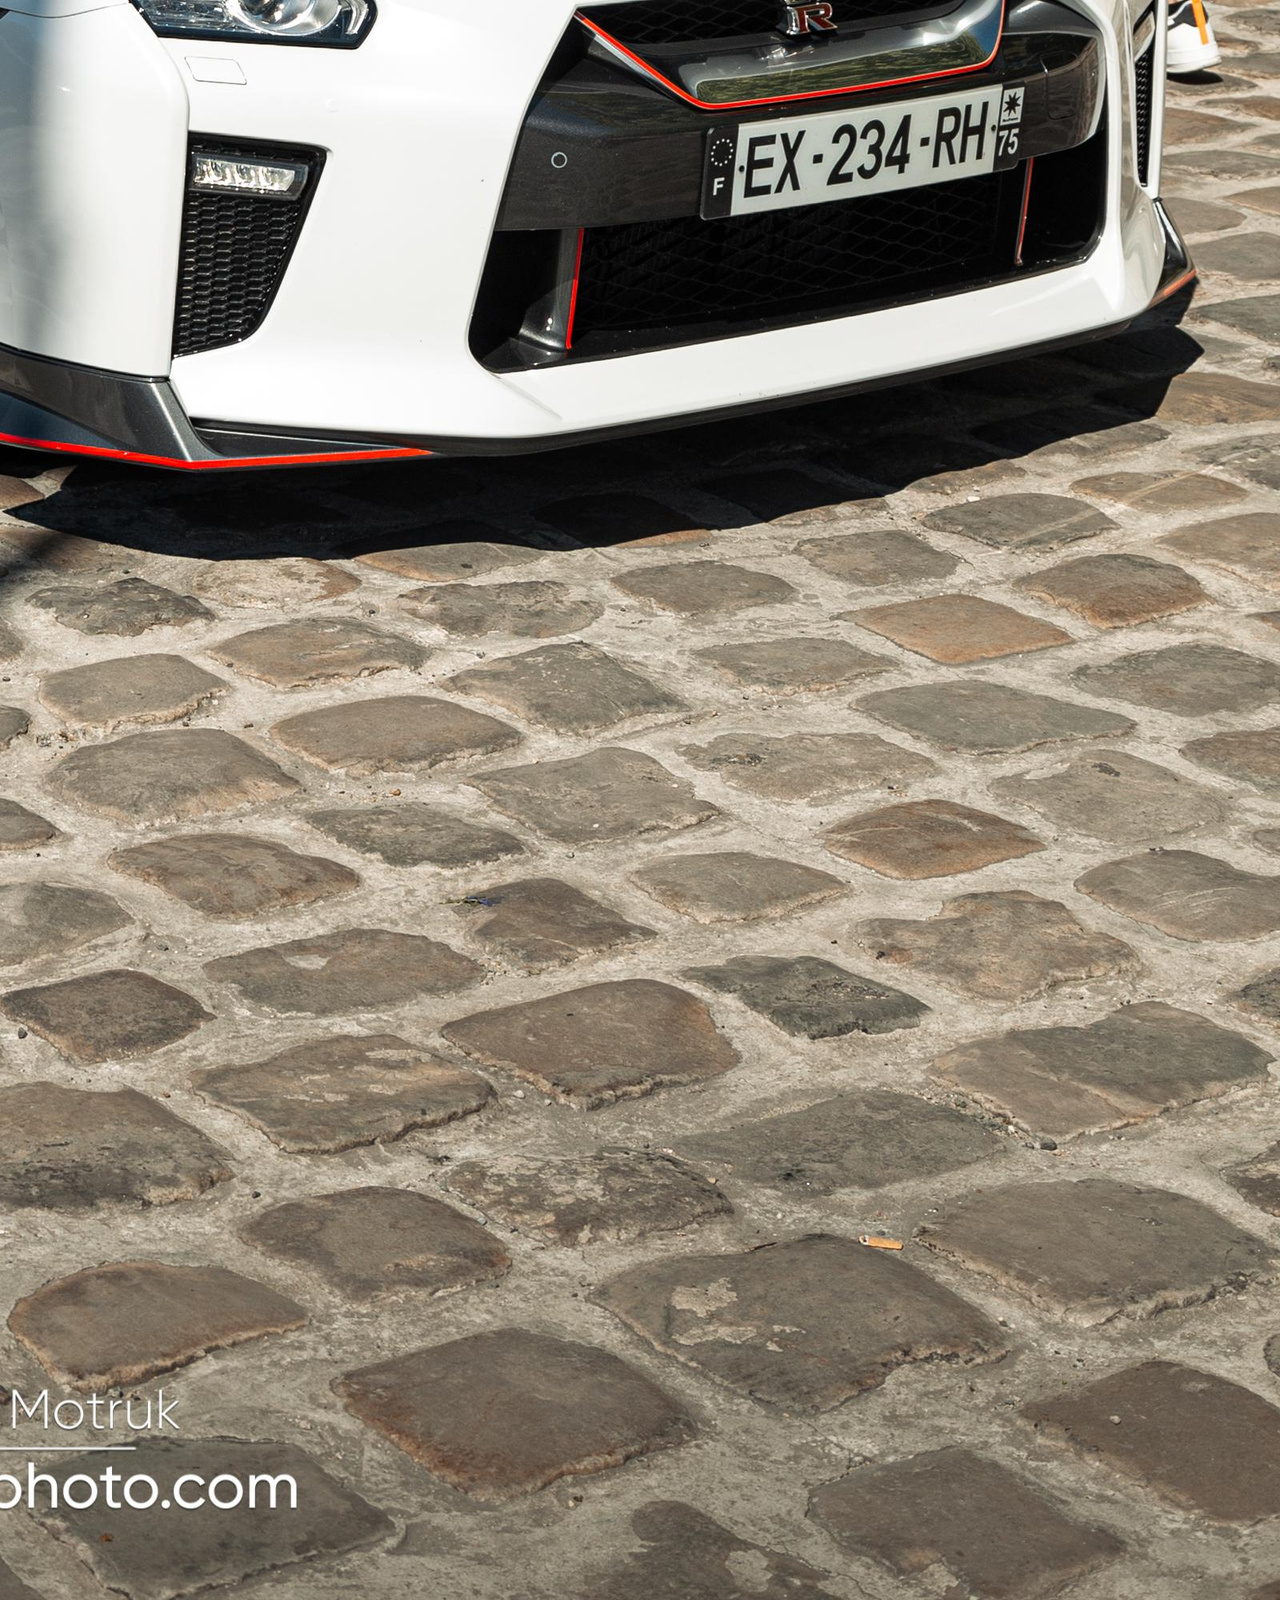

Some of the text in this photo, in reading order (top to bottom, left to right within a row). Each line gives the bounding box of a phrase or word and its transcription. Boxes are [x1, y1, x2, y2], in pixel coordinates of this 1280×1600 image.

[712, 100, 1020, 199] F EX-234-RH 75
